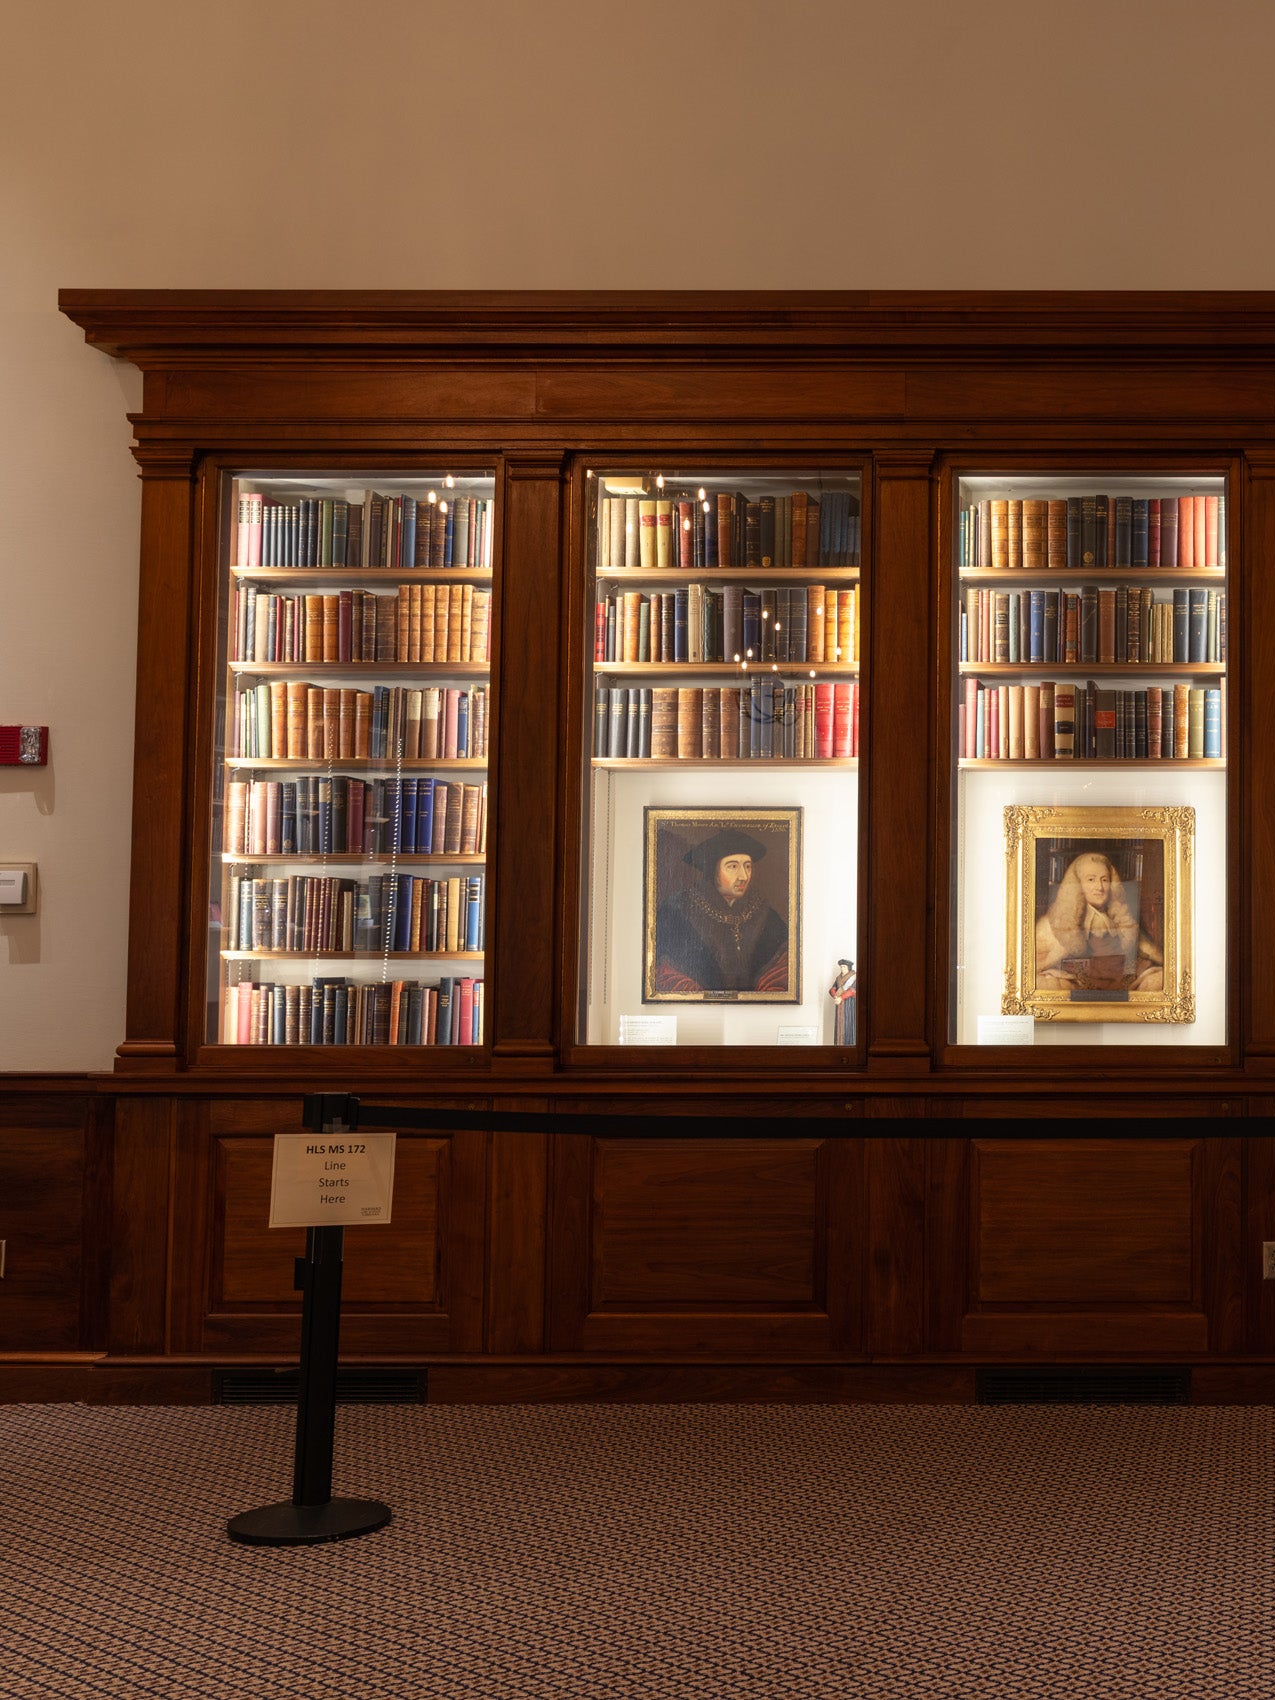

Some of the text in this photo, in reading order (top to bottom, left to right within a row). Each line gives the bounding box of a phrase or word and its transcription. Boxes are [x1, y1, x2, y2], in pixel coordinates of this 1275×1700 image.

[306, 1144, 366, 1154] HLS MS 172
[324, 1161, 346, 1170] Line
[318, 1177, 350, 1187] Starts
[320, 1194, 346, 1204] Here
